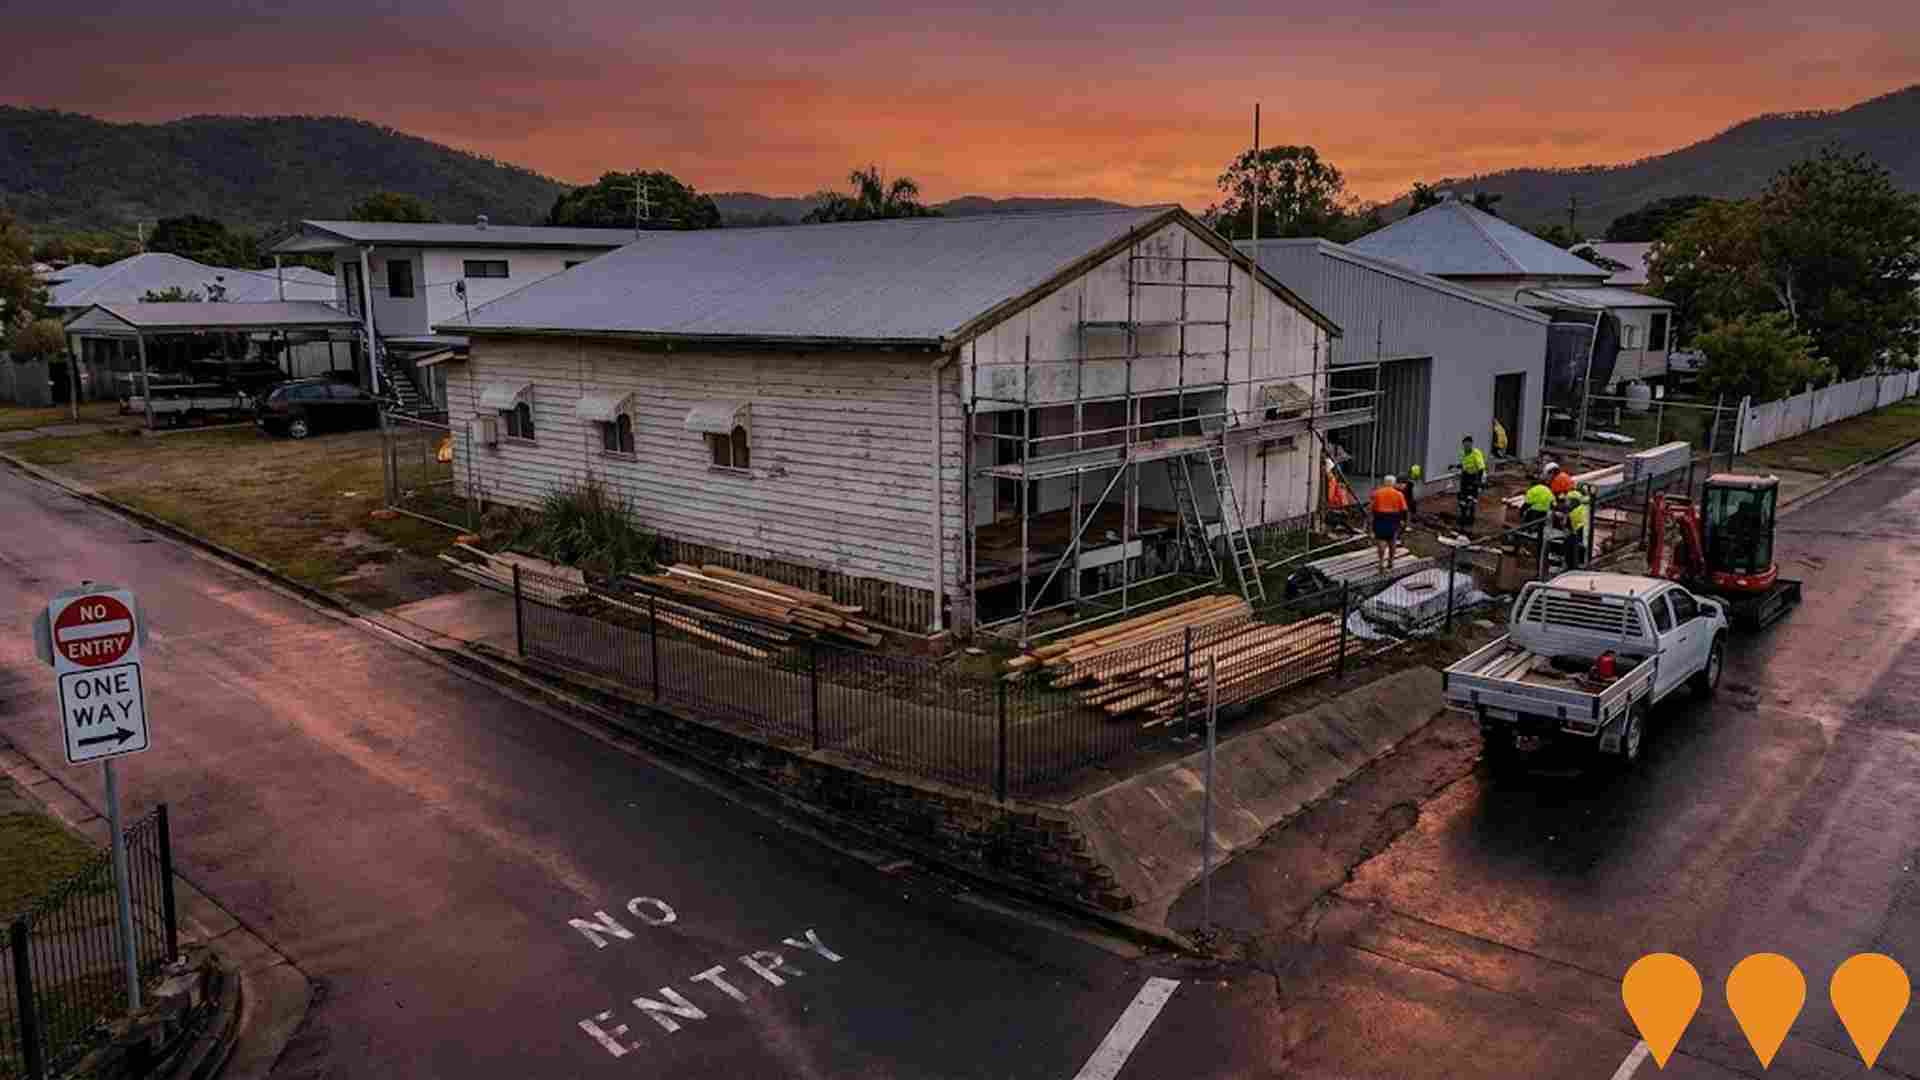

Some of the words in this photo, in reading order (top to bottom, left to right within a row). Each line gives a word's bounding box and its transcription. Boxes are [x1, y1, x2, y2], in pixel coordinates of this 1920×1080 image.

[80, 604, 107, 621] NO
[68, 637, 126, 659] ENTRY
[75, 673, 130, 699] ONE
[73, 699, 134, 728] WAY
[567, 896, 678, 949] NO
[577, 928, 845, 1058] ENTRY
